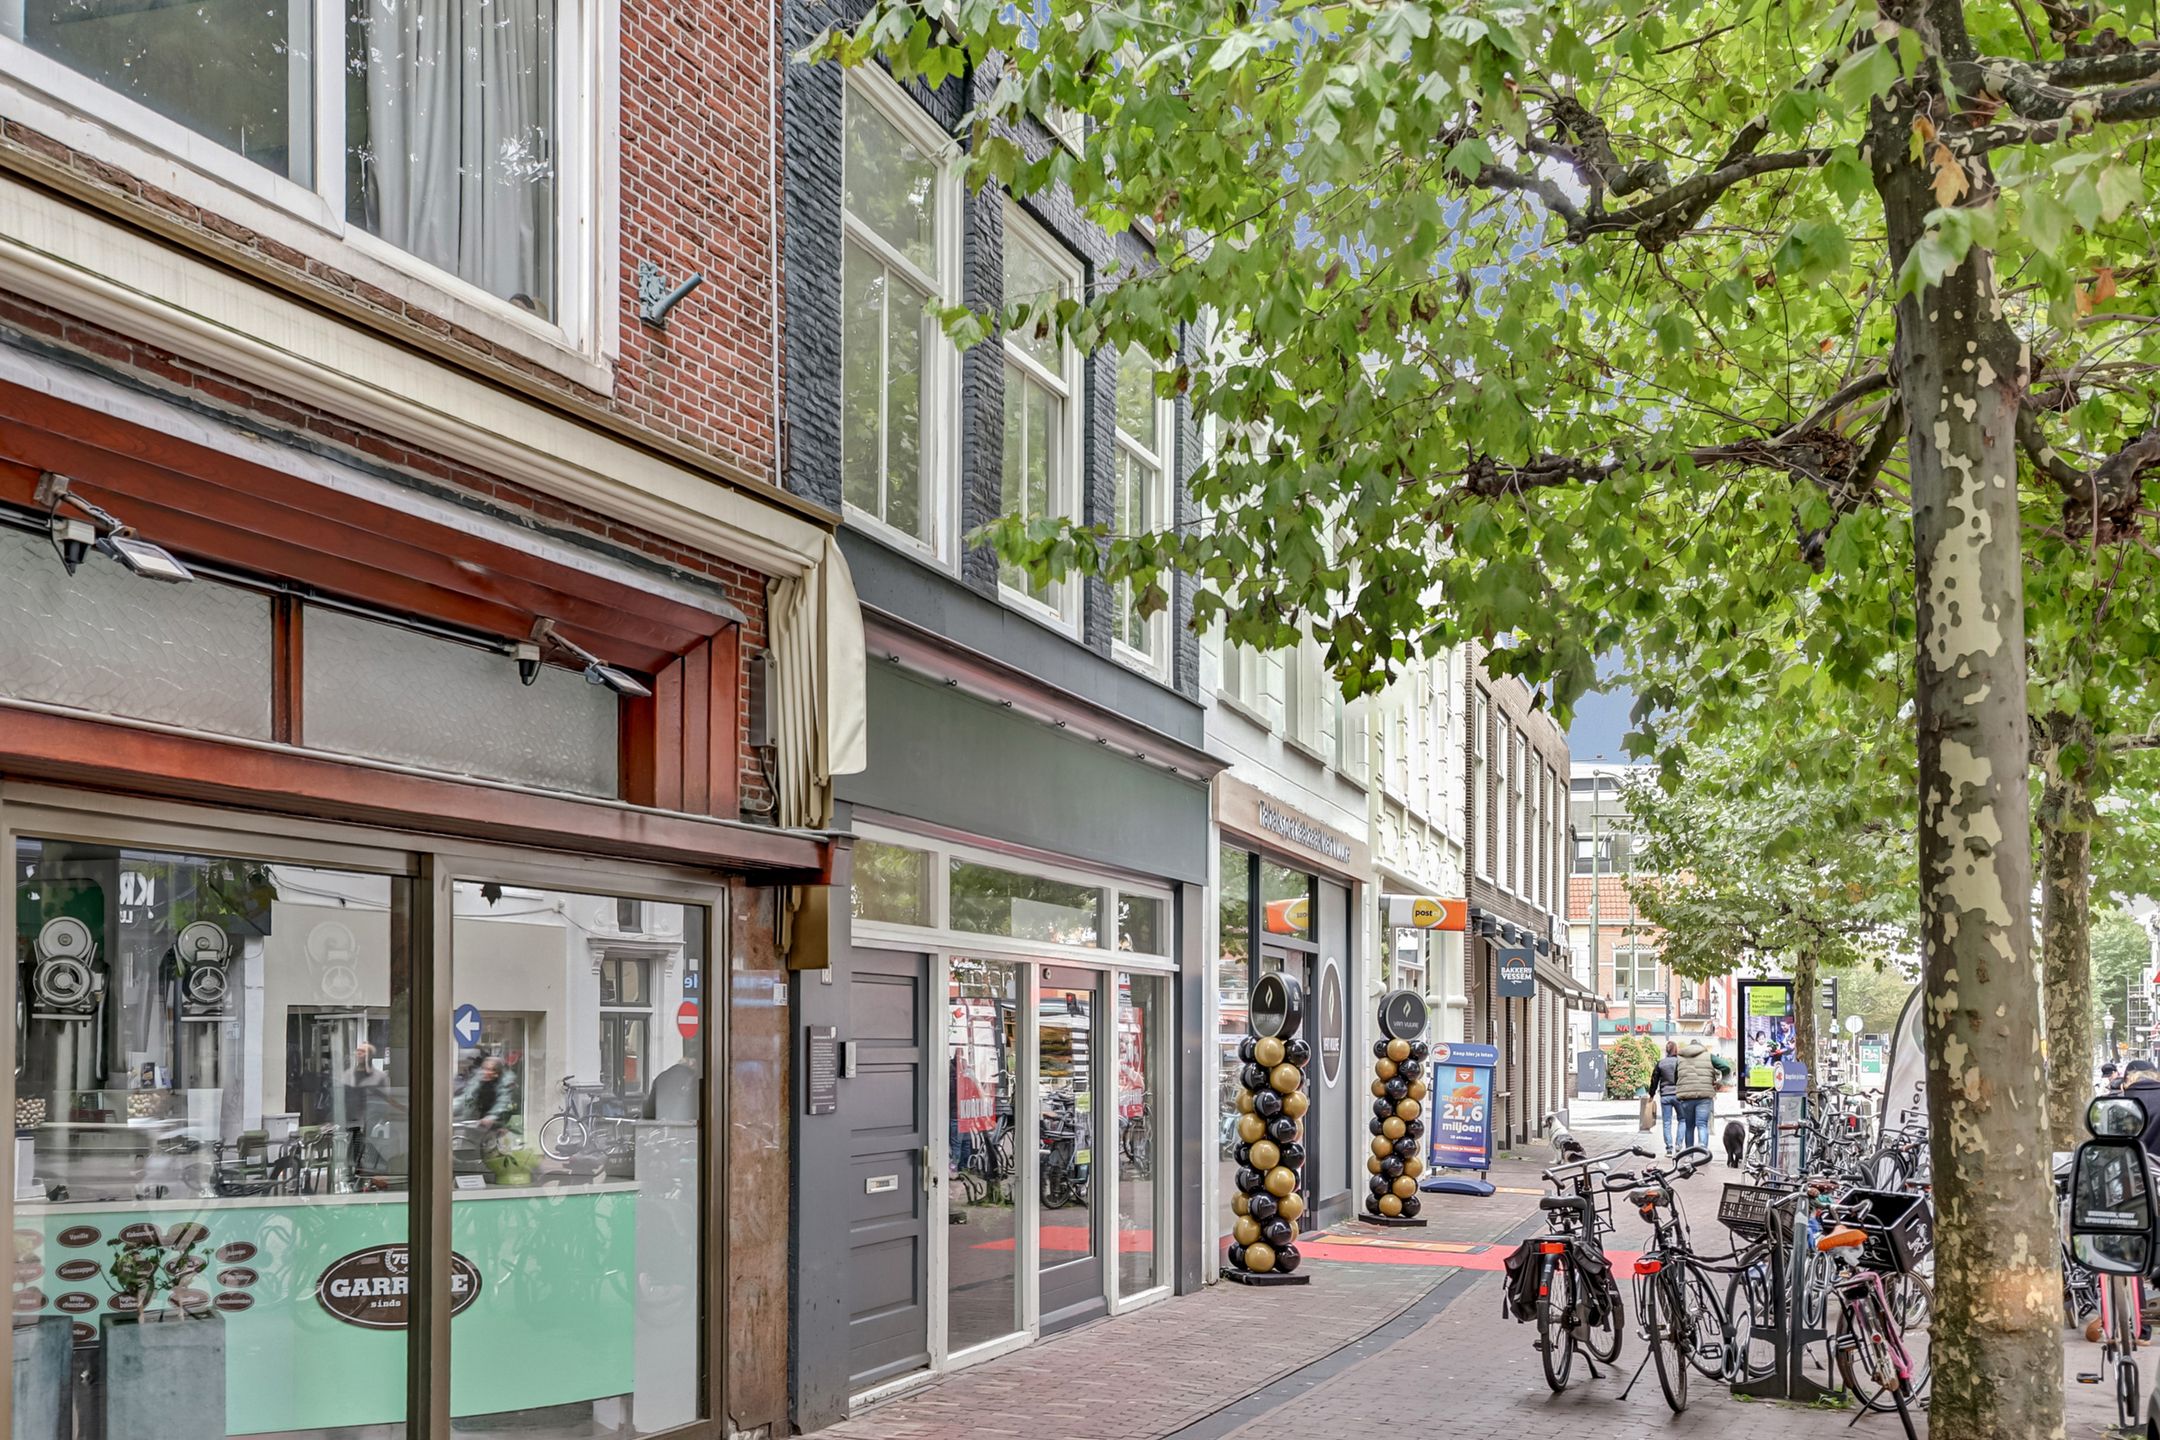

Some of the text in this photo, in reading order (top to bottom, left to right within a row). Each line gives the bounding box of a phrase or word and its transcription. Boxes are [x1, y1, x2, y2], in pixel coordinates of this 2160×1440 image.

[1616, 1022, 1652, 1032] NAOLI
[1443, 1103, 1483, 1122] 21,6
[1442, 1122, 1482, 1133] miljoen
[330, 1273, 469, 1298] GARRE
[370, 1299, 401, 1309] sinds
